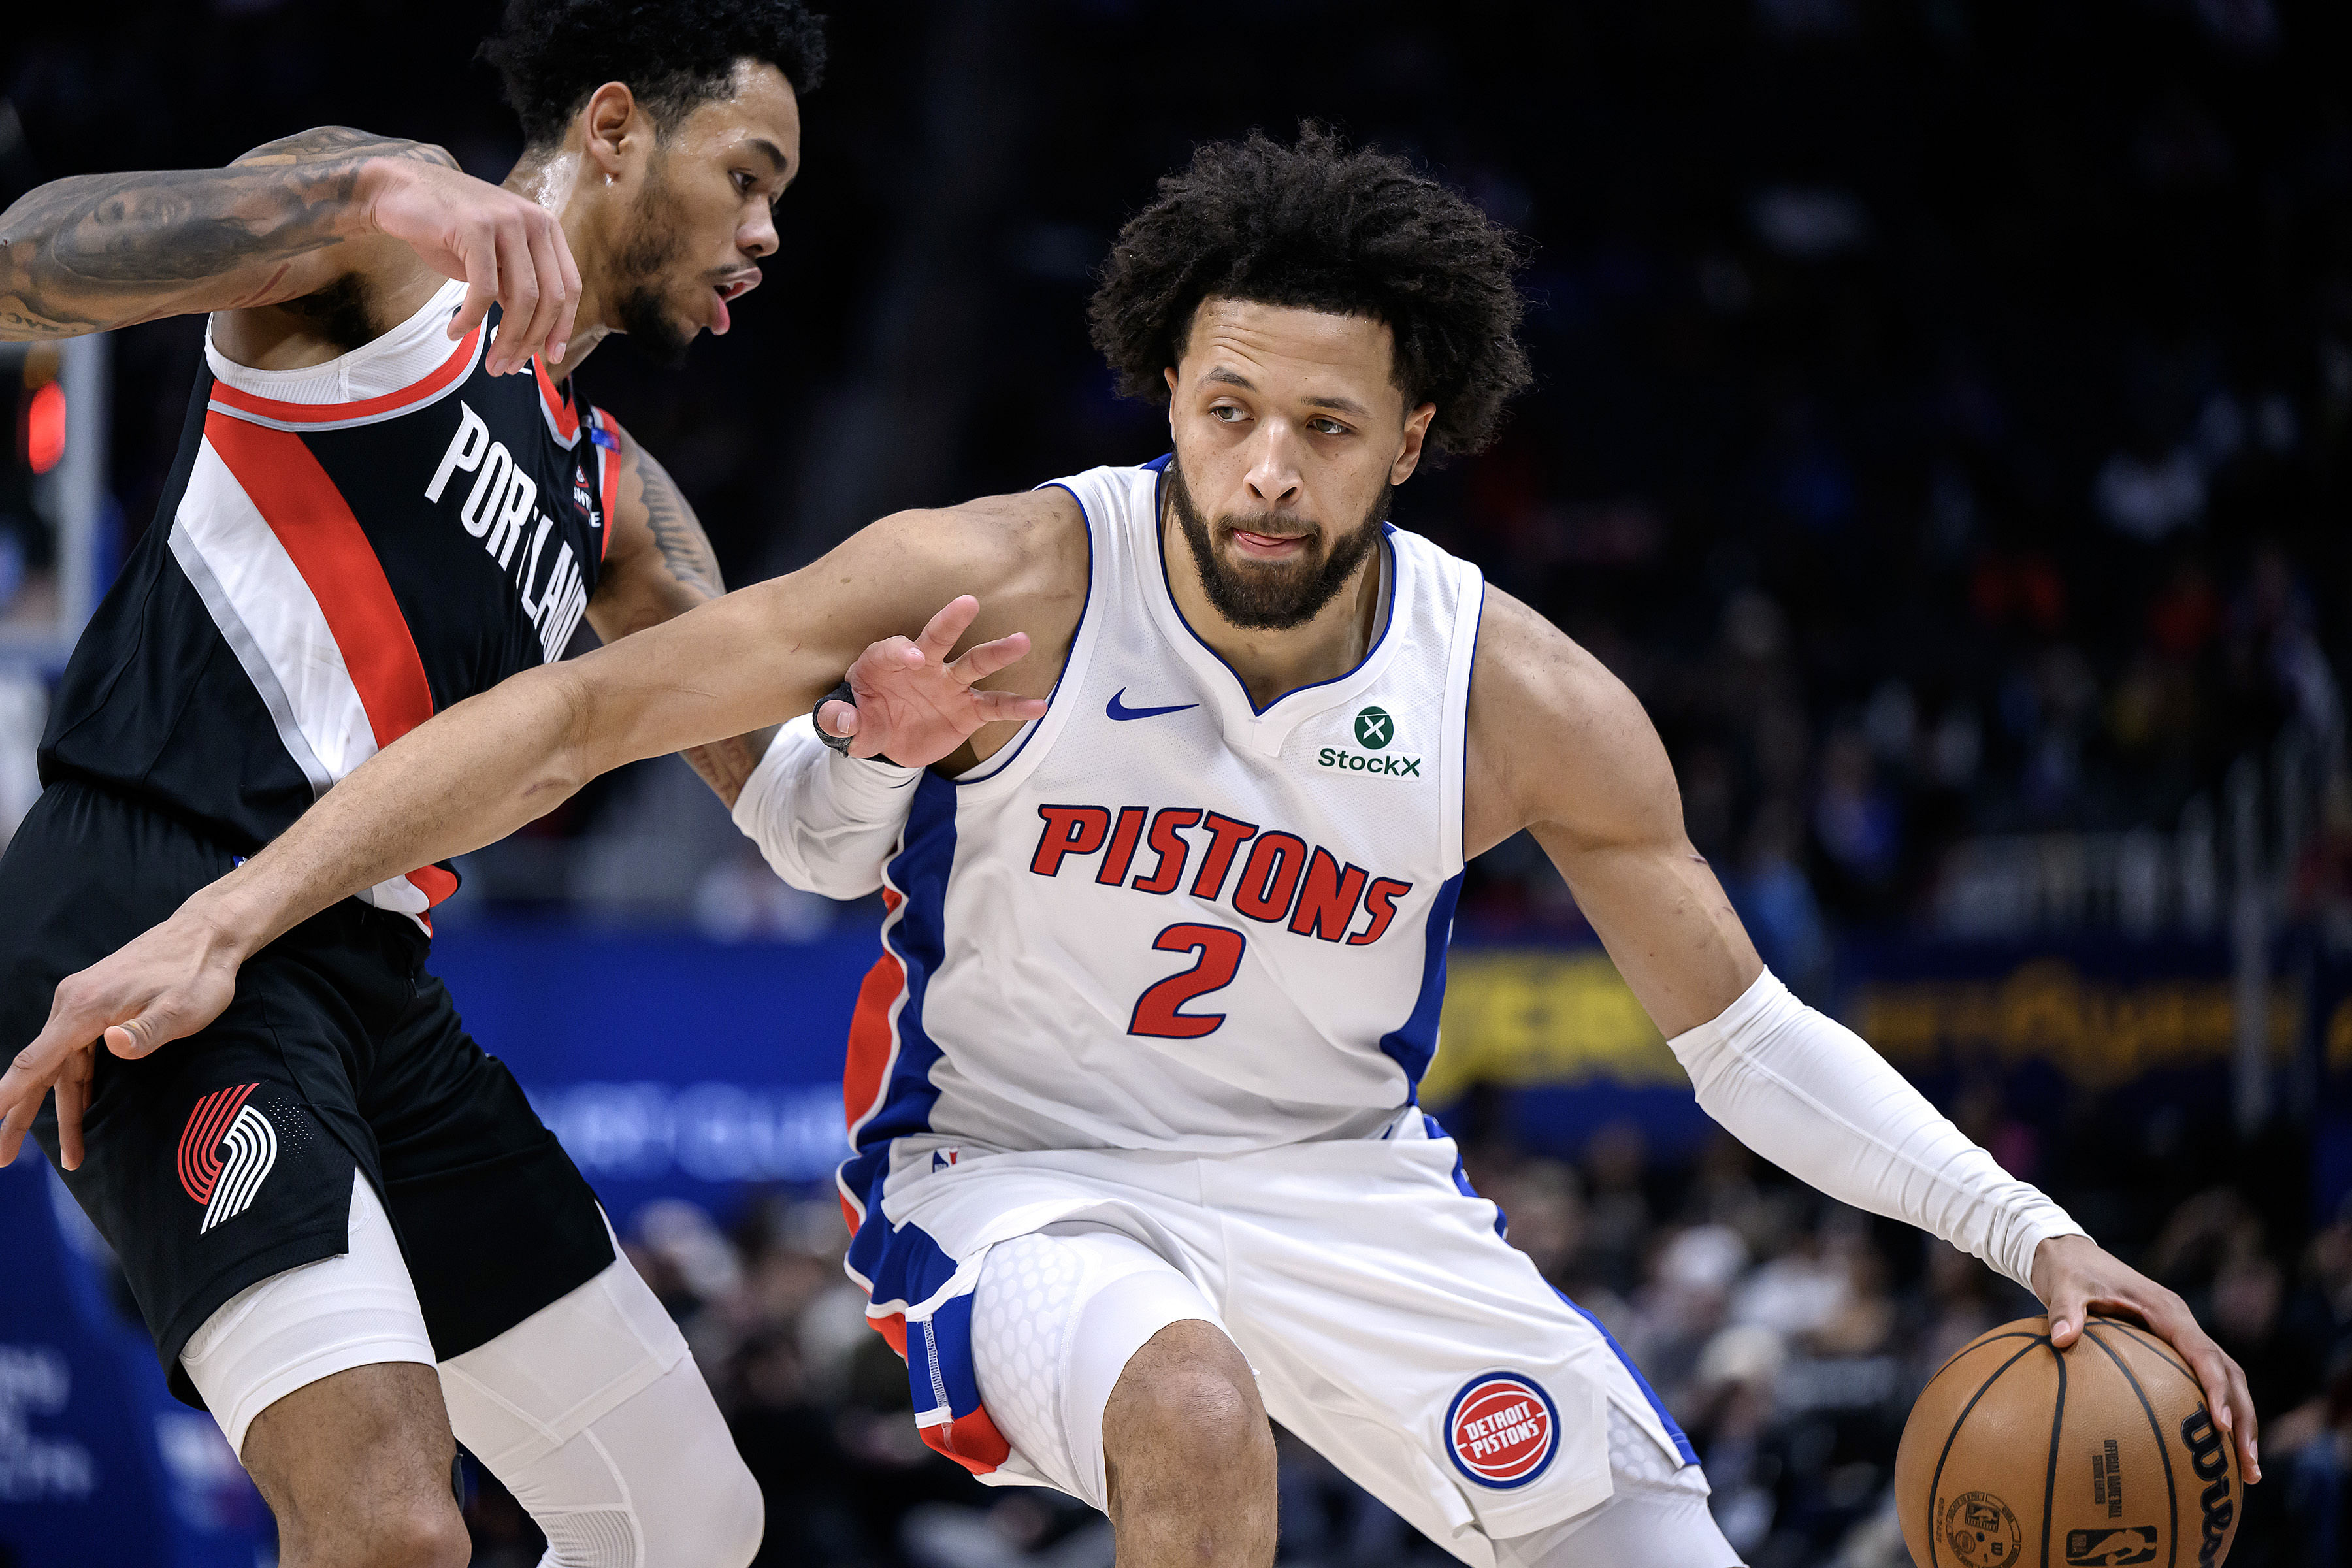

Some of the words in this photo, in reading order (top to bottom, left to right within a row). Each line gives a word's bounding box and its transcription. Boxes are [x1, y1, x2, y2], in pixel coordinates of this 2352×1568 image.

[425, 400, 587, 664] PORLAND
[1318, 748, 1421, 778] StockX
[1030, 804, 1413, 945] PISTONS
[1127, 922, 1246, 1039] 2
[1463, 1400, 1531, 1441] DETROIT
[1469, 1418, 1540, 1460] PISTONS
